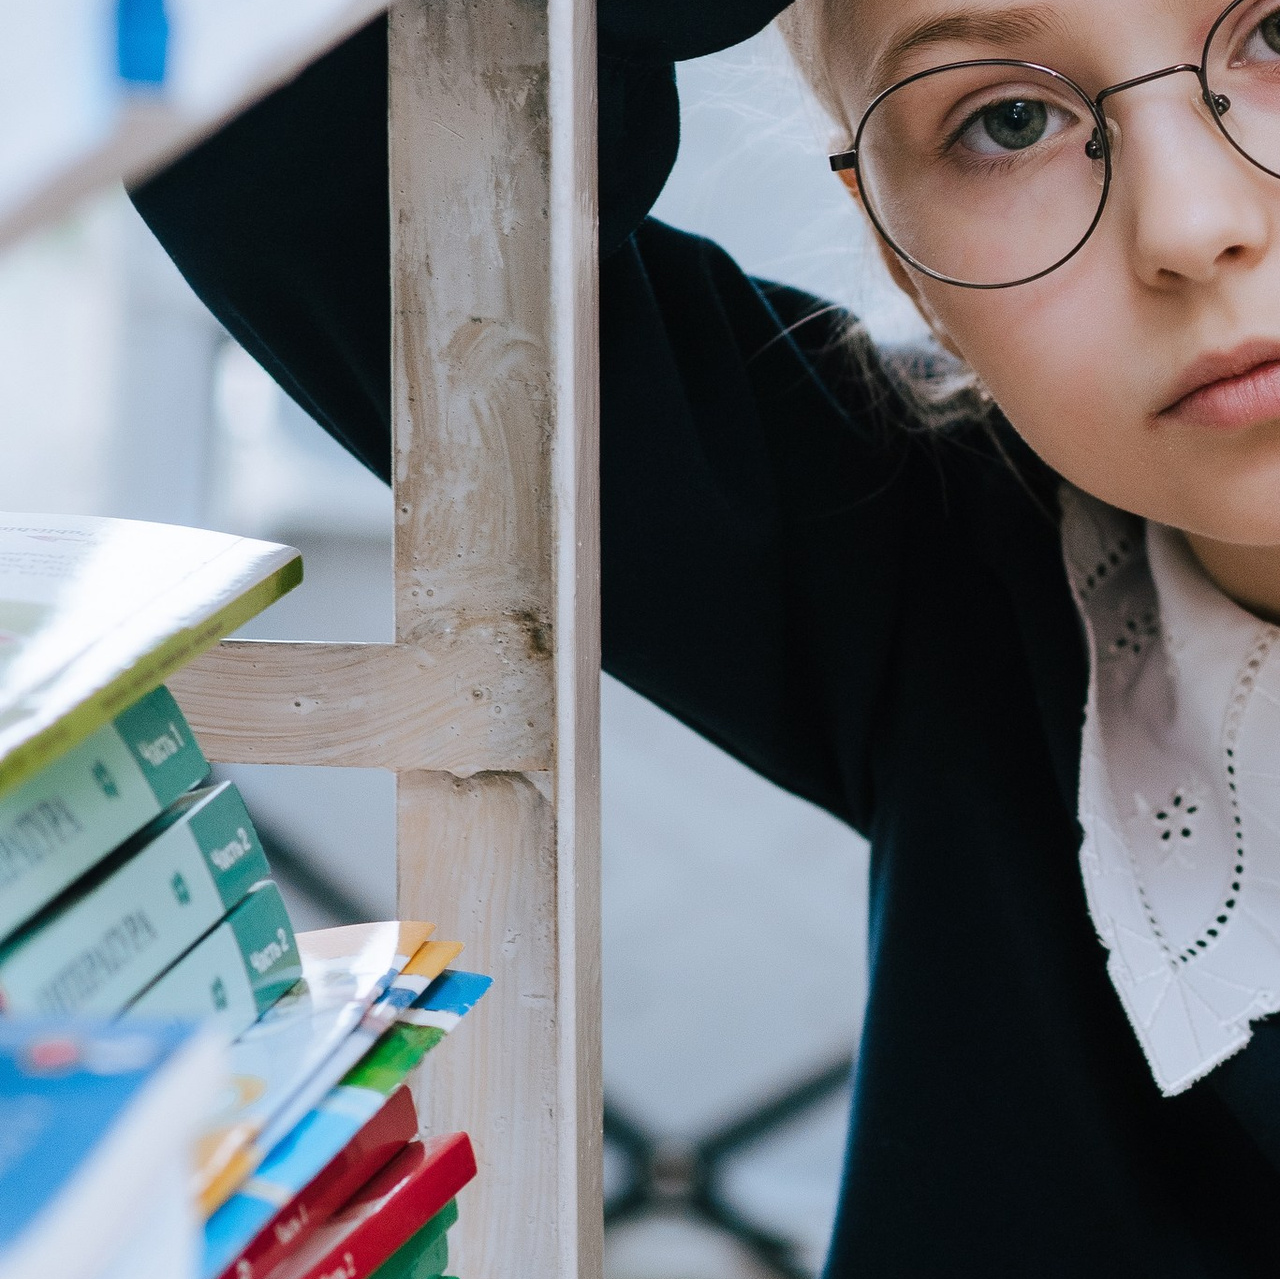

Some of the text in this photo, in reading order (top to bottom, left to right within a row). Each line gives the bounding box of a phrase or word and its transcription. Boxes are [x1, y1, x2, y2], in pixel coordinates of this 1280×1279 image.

[168, 721, 186, 748] 1
[236, 826, 253, 851] 2
[276, 926, 291, 953] 2
